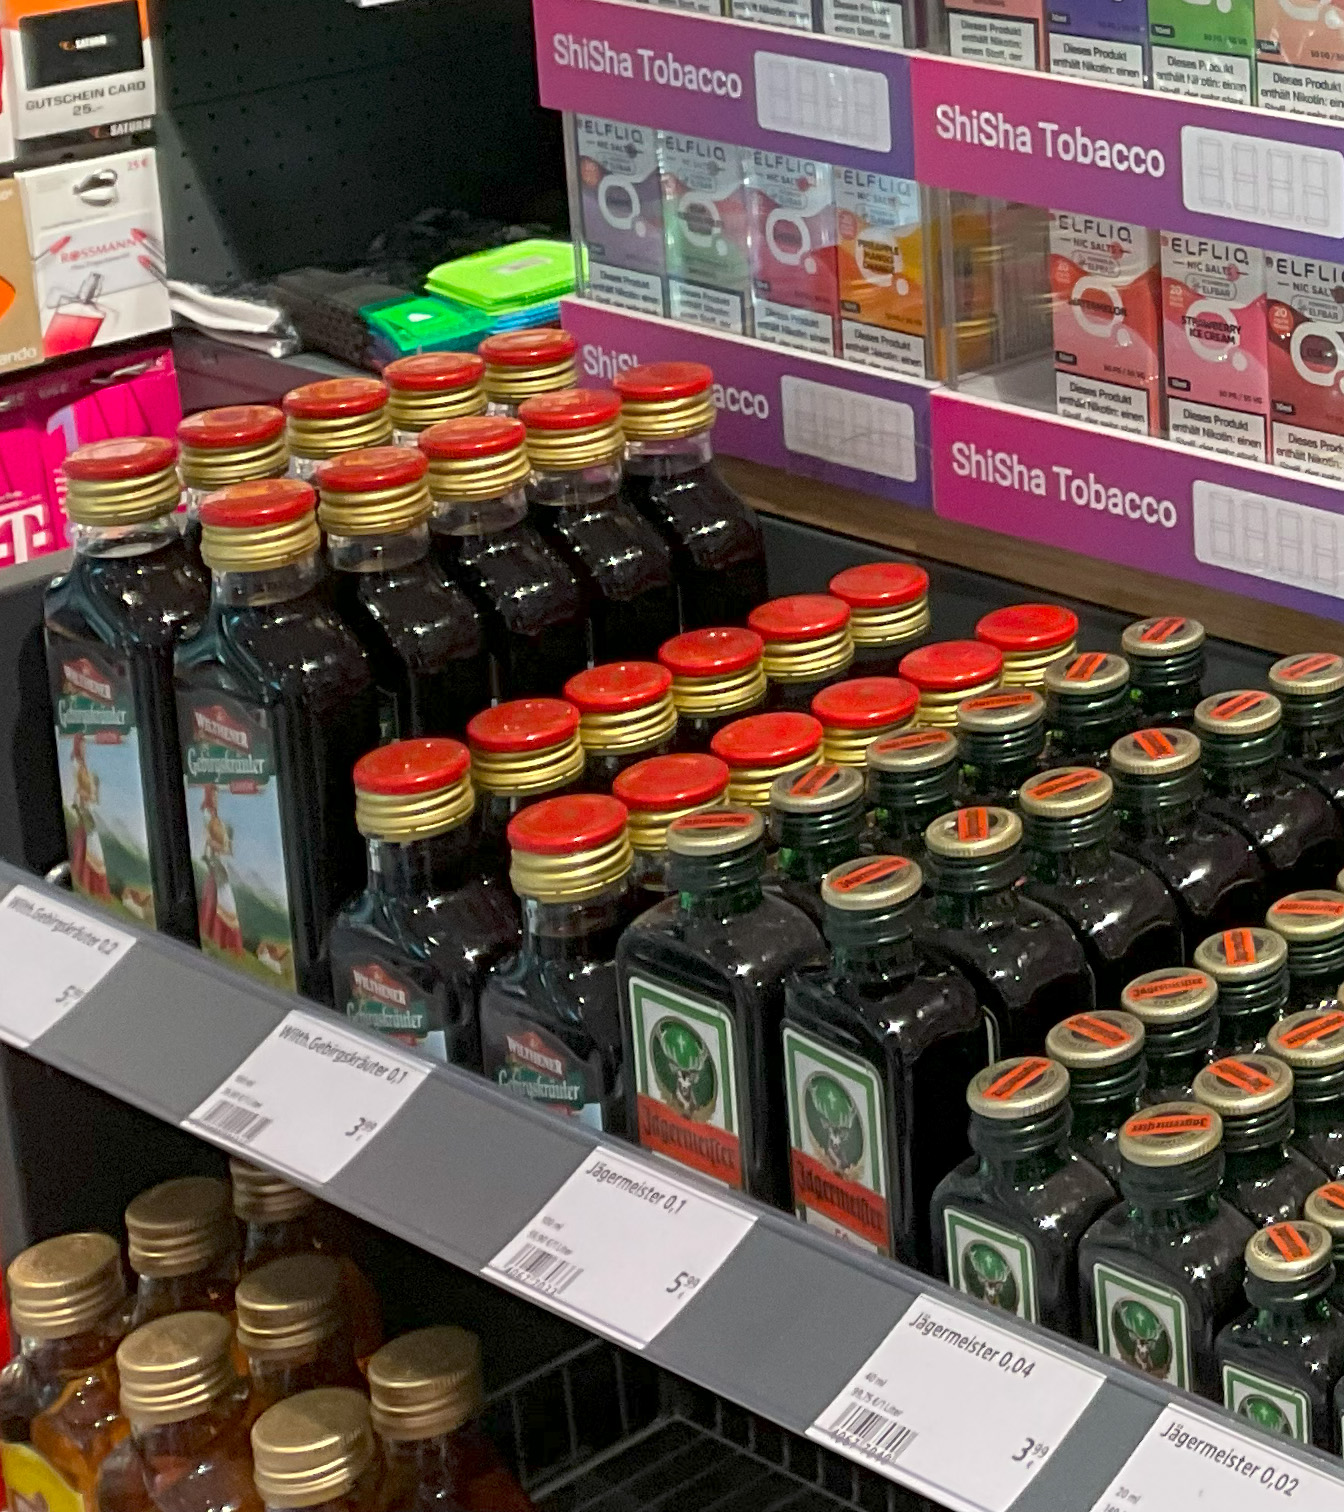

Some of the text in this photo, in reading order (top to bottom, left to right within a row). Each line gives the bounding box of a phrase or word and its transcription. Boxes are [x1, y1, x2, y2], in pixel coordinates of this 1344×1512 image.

[26, 79, 146, 111] GUTSCHEIN CARD
[553, 33, 742, 99] ShiSha Tobacco
[936, 104, 1166, 178] ShiSha Tobacco
[60, 239, 138, 263] ROSSMANN
[952, 441, 1177, 529] ShiSha Tobacco
[387, 1067, 407, 1085] 0,1
[586, 1160, 687, 1215] Jägermeister 0,1
[909, 1310, 1035, 1379] Jägermeister 0,04
[1160, 1421, 1299, 1497] Jägermeister 0,02
